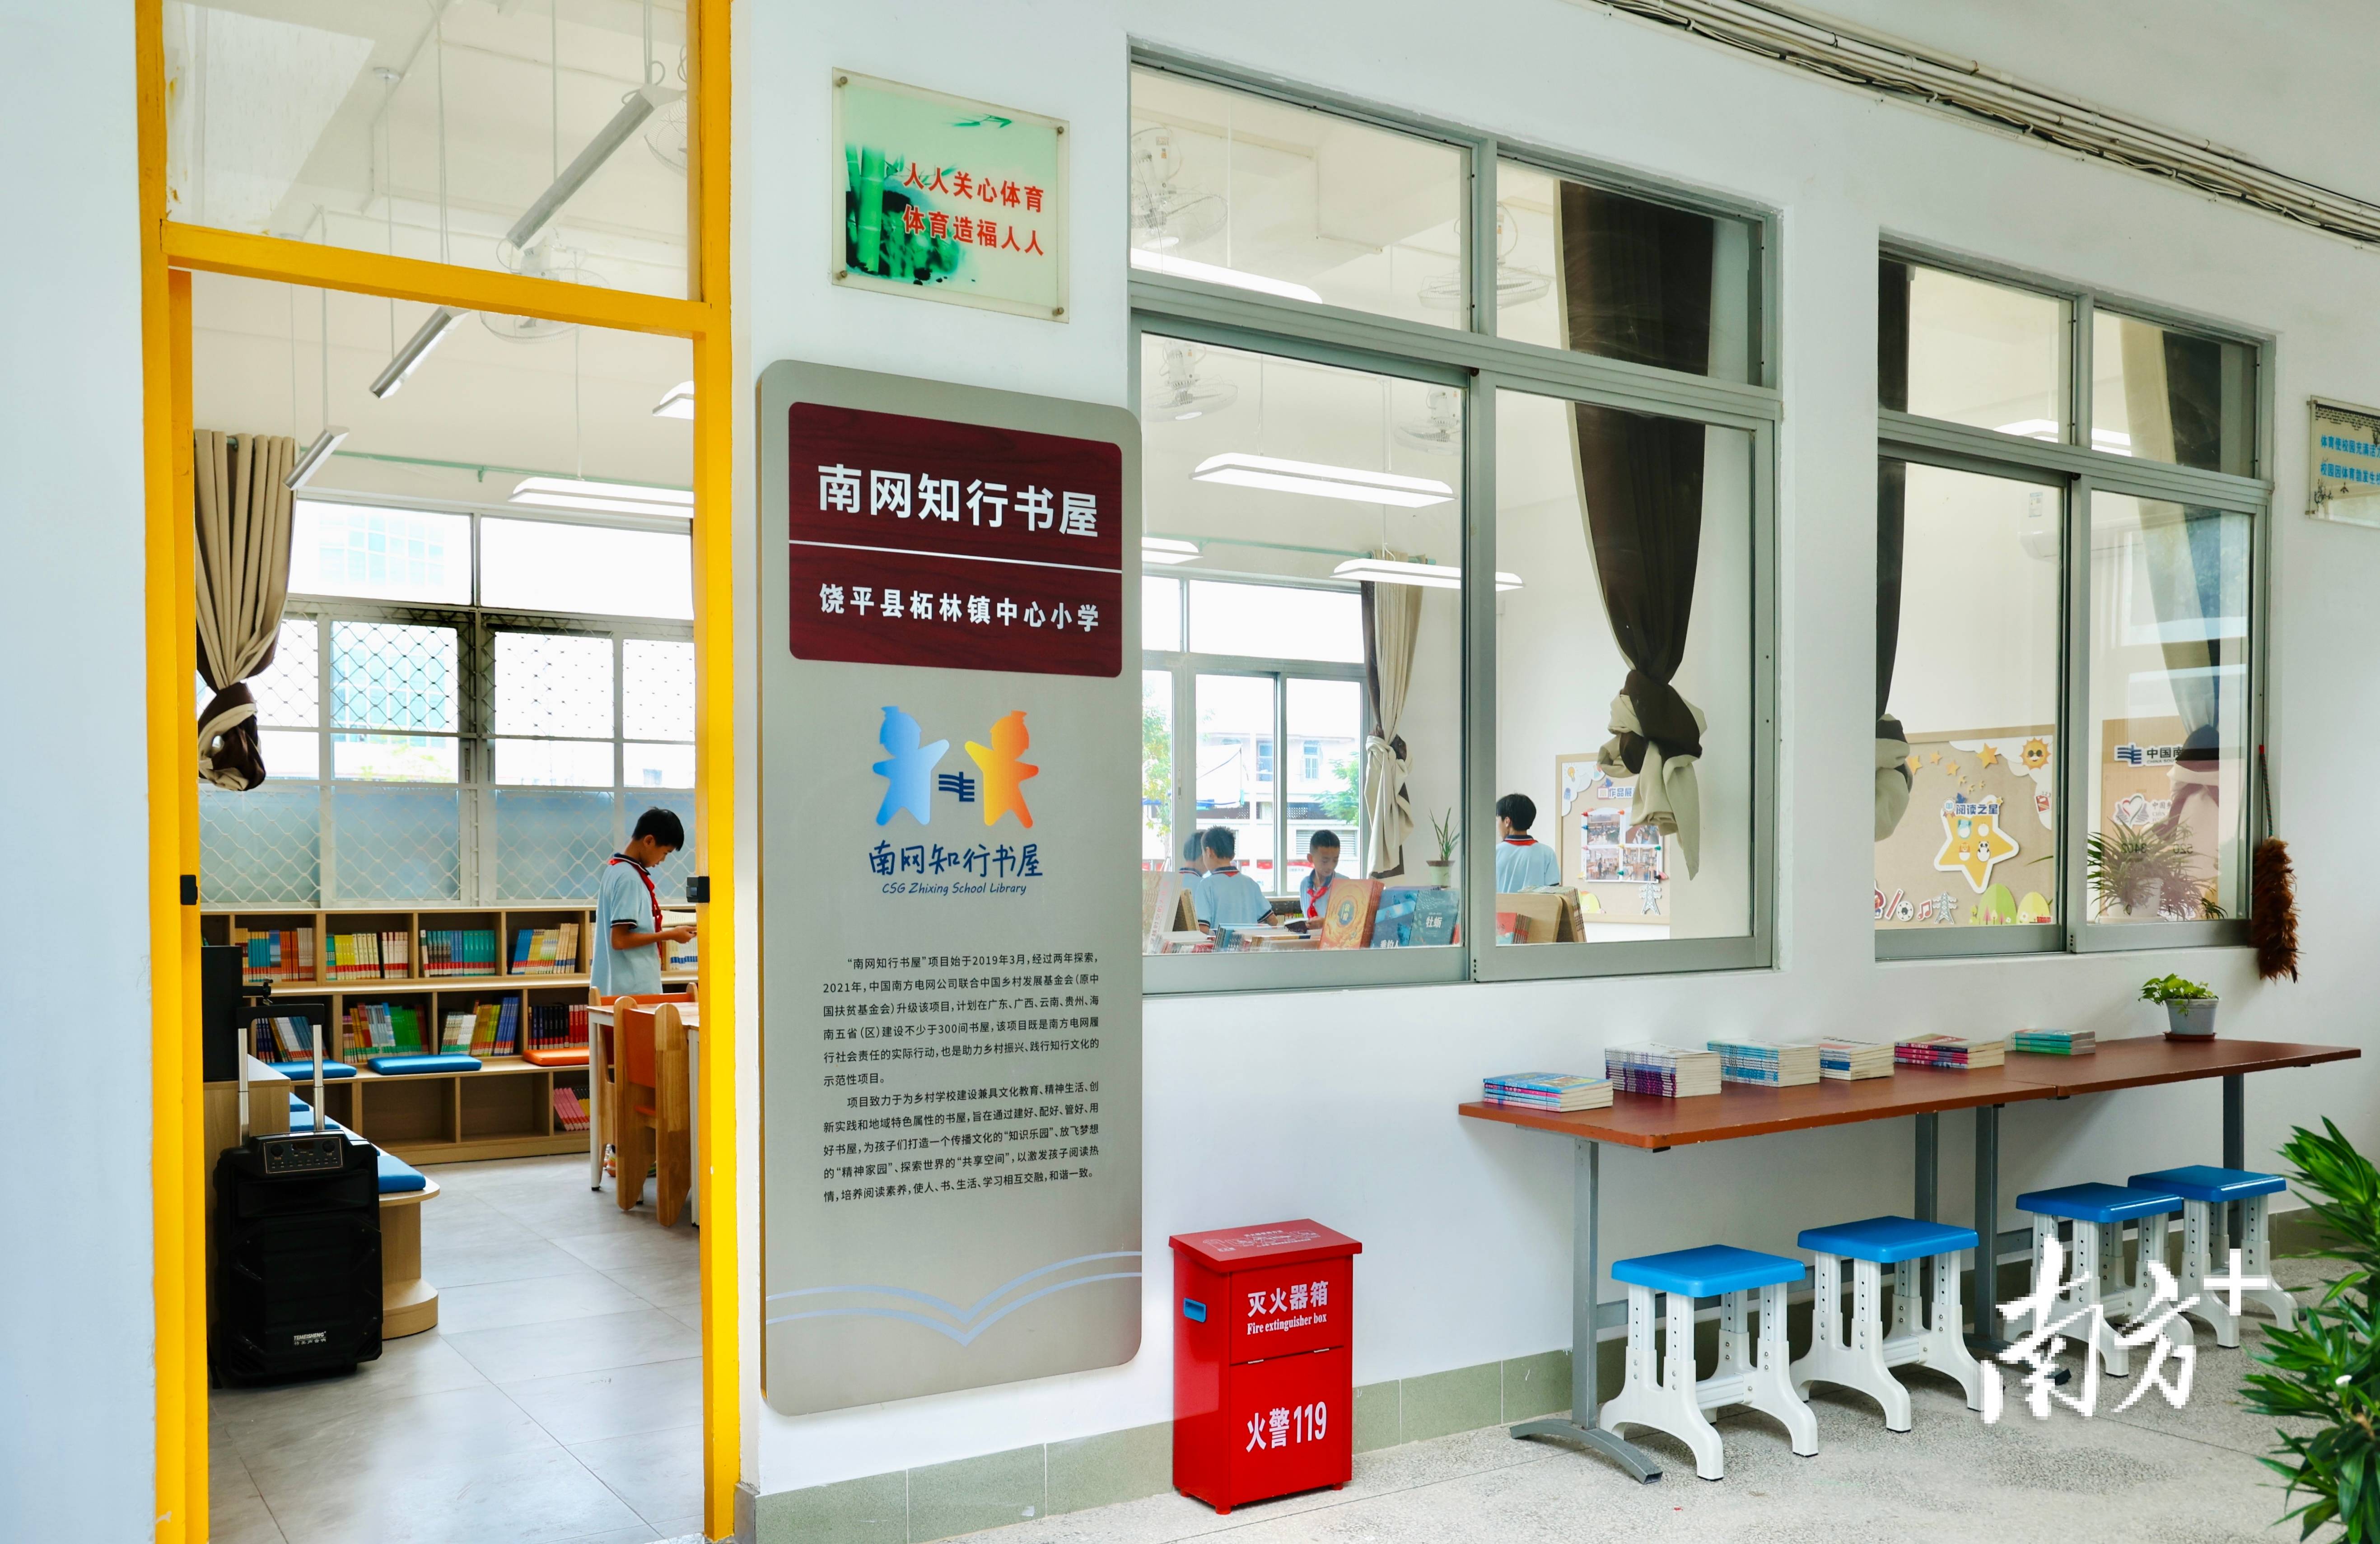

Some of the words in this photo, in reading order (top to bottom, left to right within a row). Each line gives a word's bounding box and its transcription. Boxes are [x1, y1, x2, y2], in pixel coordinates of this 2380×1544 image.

[903, 162, 1044, 213] 人人关心体育
[903, 205, 1044, 256] 体育造福人人
[818, 463, 1098, 537] 南网知行书屋
[819, 583, 1099, 632] 饶平县柘林镇中心小学
[1609, 787, 1635, 798] 作品展
[1955, 803, 1999, 815] 阅读之星
[869, 840, 1043, 877] 南网知行书屋
[882, 882, 905, 893] CSG
[909, 882, 948, 896] Zhixing
[952, 882, 985, 894] School
[989, 882, 1027, 896] Library
[1426, 916, 1443, 928] 牡蛎
[823, 1073, 886, 1087] 示范性项目。
[1247, 1280, 1329, 1317] 灭火器箱
[1247, 1321, 1264, 1335] Fire
[1265, 1316, 1312, 1334] extinguisher
[1313, 1313, 1327, 1323] box
[1246, 1401, 1327, 1453] 火警119
